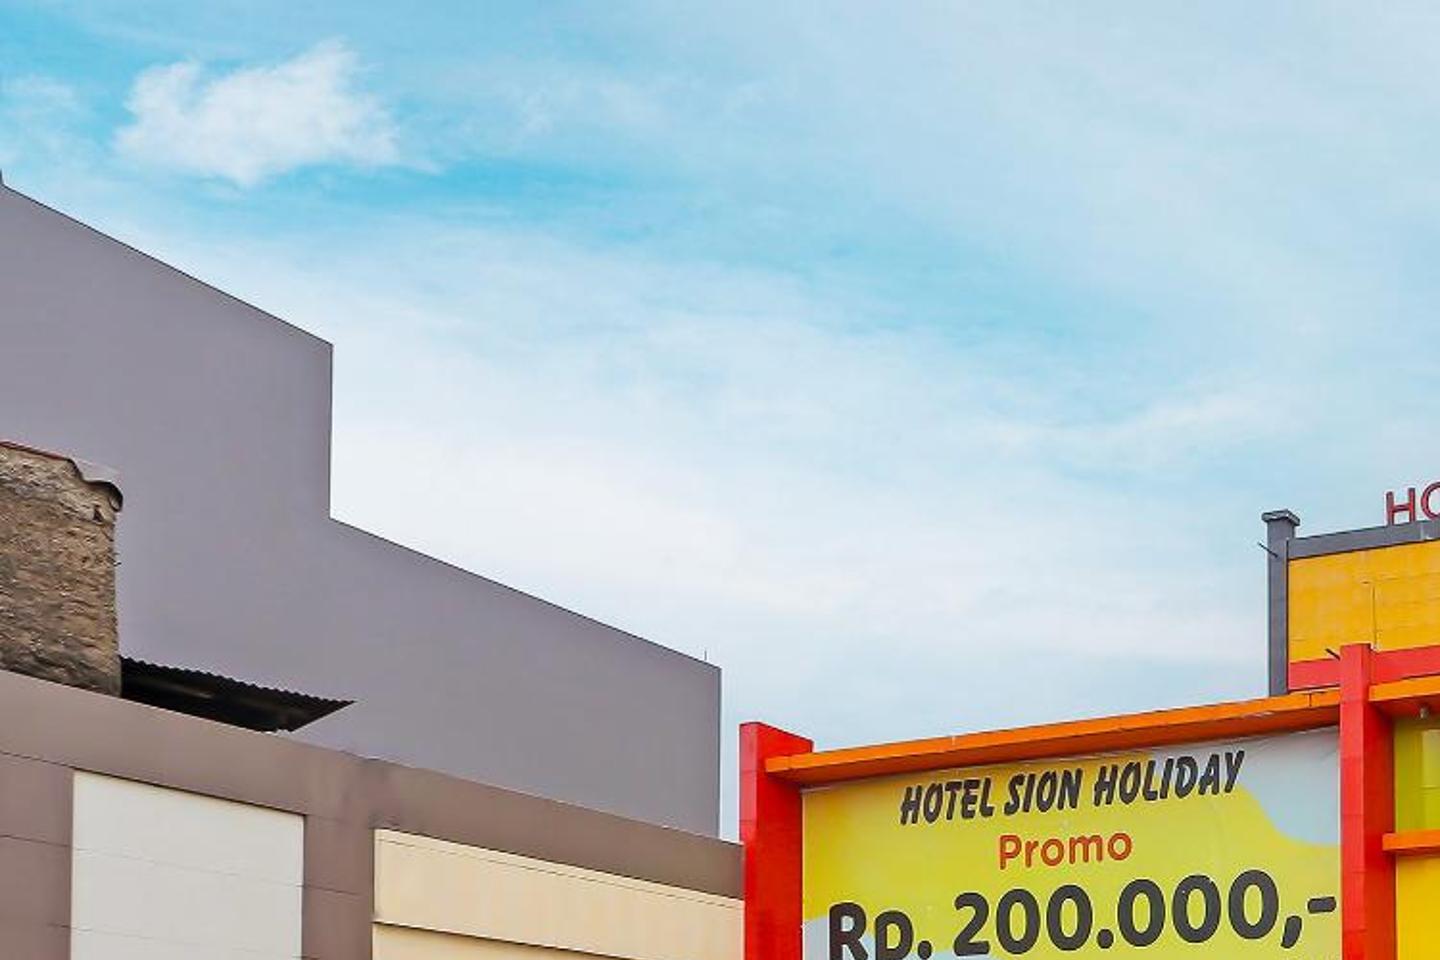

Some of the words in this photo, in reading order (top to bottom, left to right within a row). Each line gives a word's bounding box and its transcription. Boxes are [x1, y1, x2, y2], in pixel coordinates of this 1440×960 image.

[900, 776, 994, 825] HOTEL
[1003, 768, 1084, 815] SION
[1093, 750, 1245, 806] HOLIDAY
[999, 832, 1133, 870] Promo
[953, 869, 1337, 957] 200.000,-
